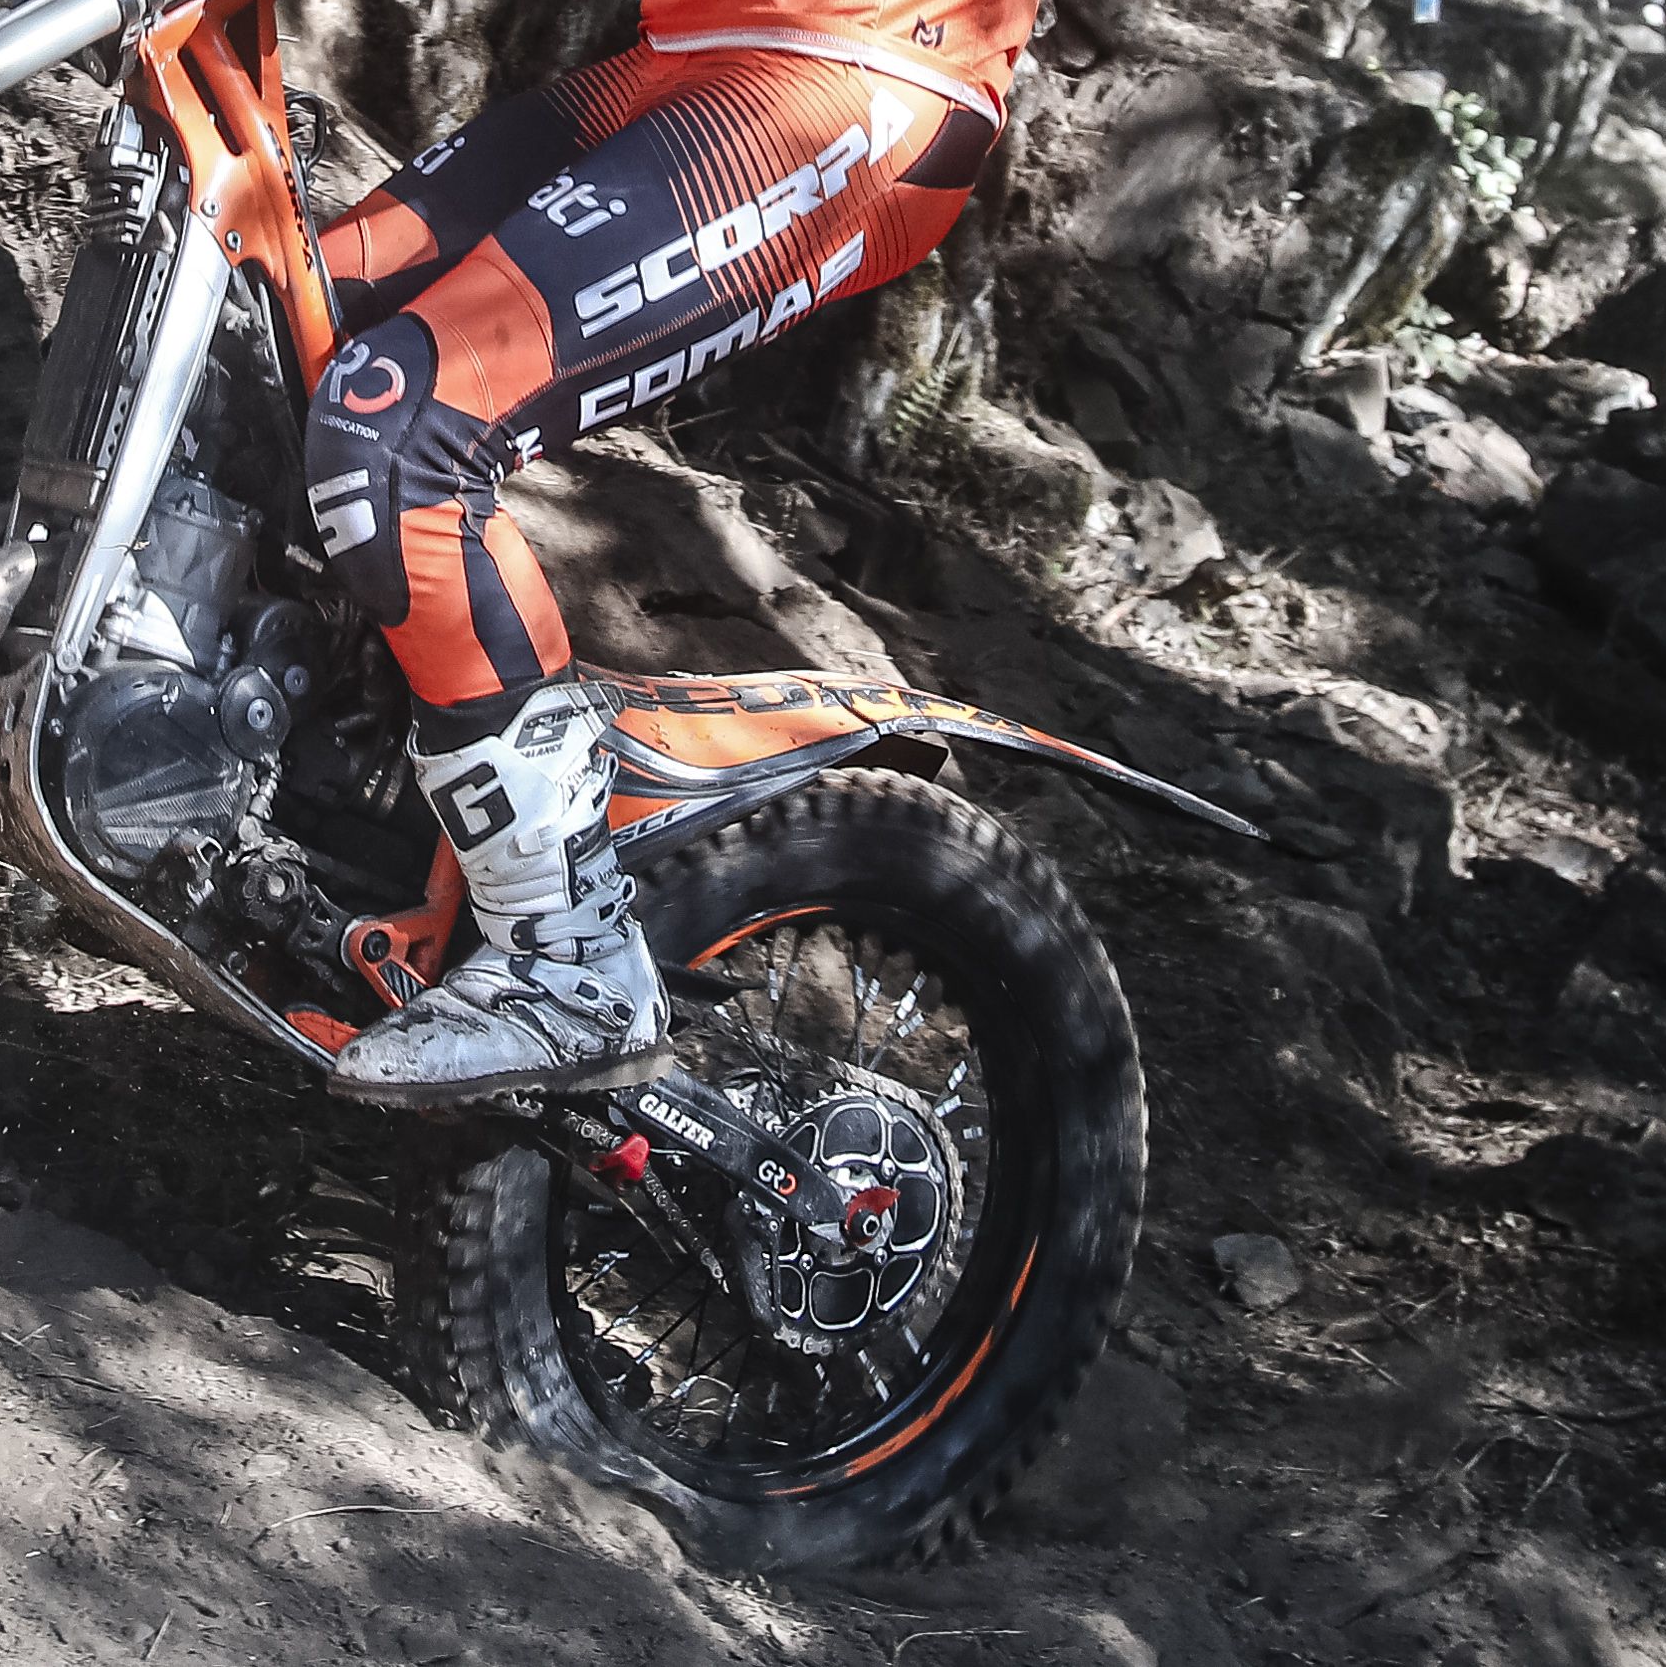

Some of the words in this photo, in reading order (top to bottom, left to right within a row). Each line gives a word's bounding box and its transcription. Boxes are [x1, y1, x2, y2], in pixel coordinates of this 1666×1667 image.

[527, 164, 629, 238] ati
[573, 84, 916, 341] SCORPA
[578, 229, 865, 432] COMAS
[638, 1092, 717, 1152] GALFER
[758, 1159, 798, 1196] GRO
